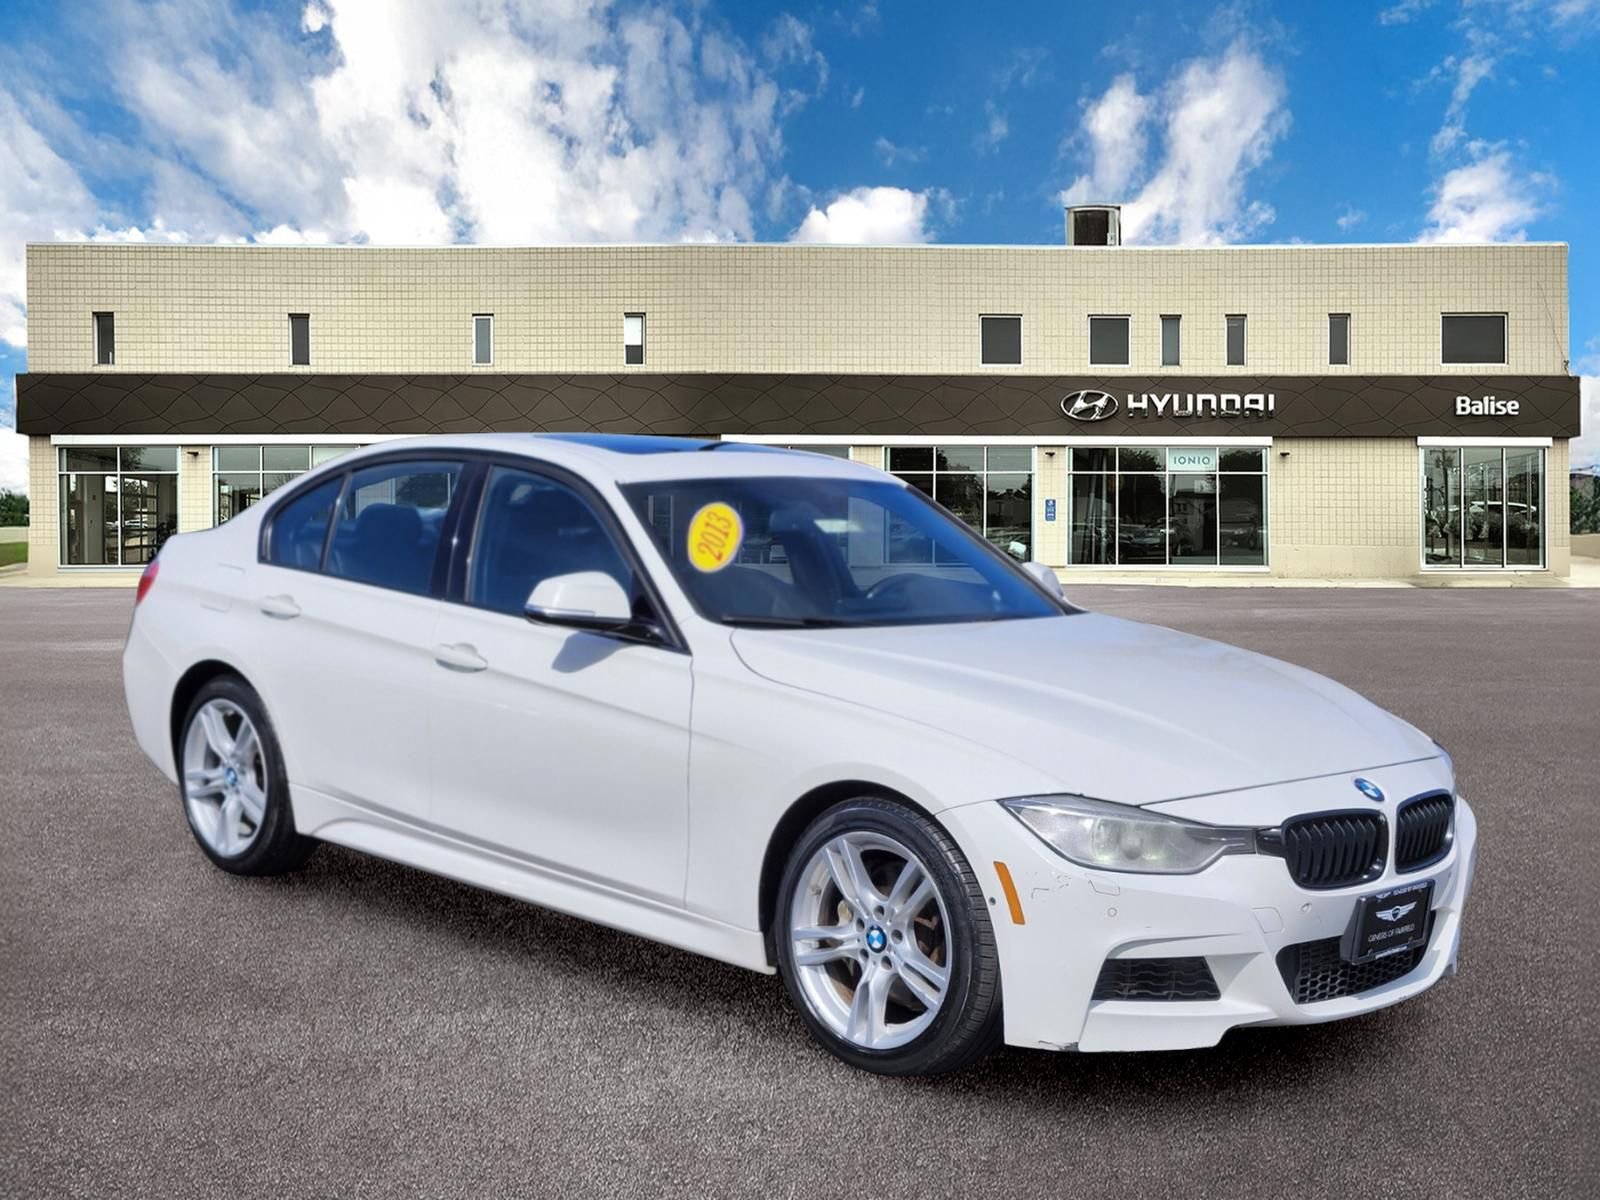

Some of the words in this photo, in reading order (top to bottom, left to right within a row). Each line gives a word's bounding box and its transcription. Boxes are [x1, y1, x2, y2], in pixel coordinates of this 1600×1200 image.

[1127, 393, 1275, 418] HYUNDAI
[1455, 395, 1520, 416] Balise
[697, 511, 732, 562] 2013
